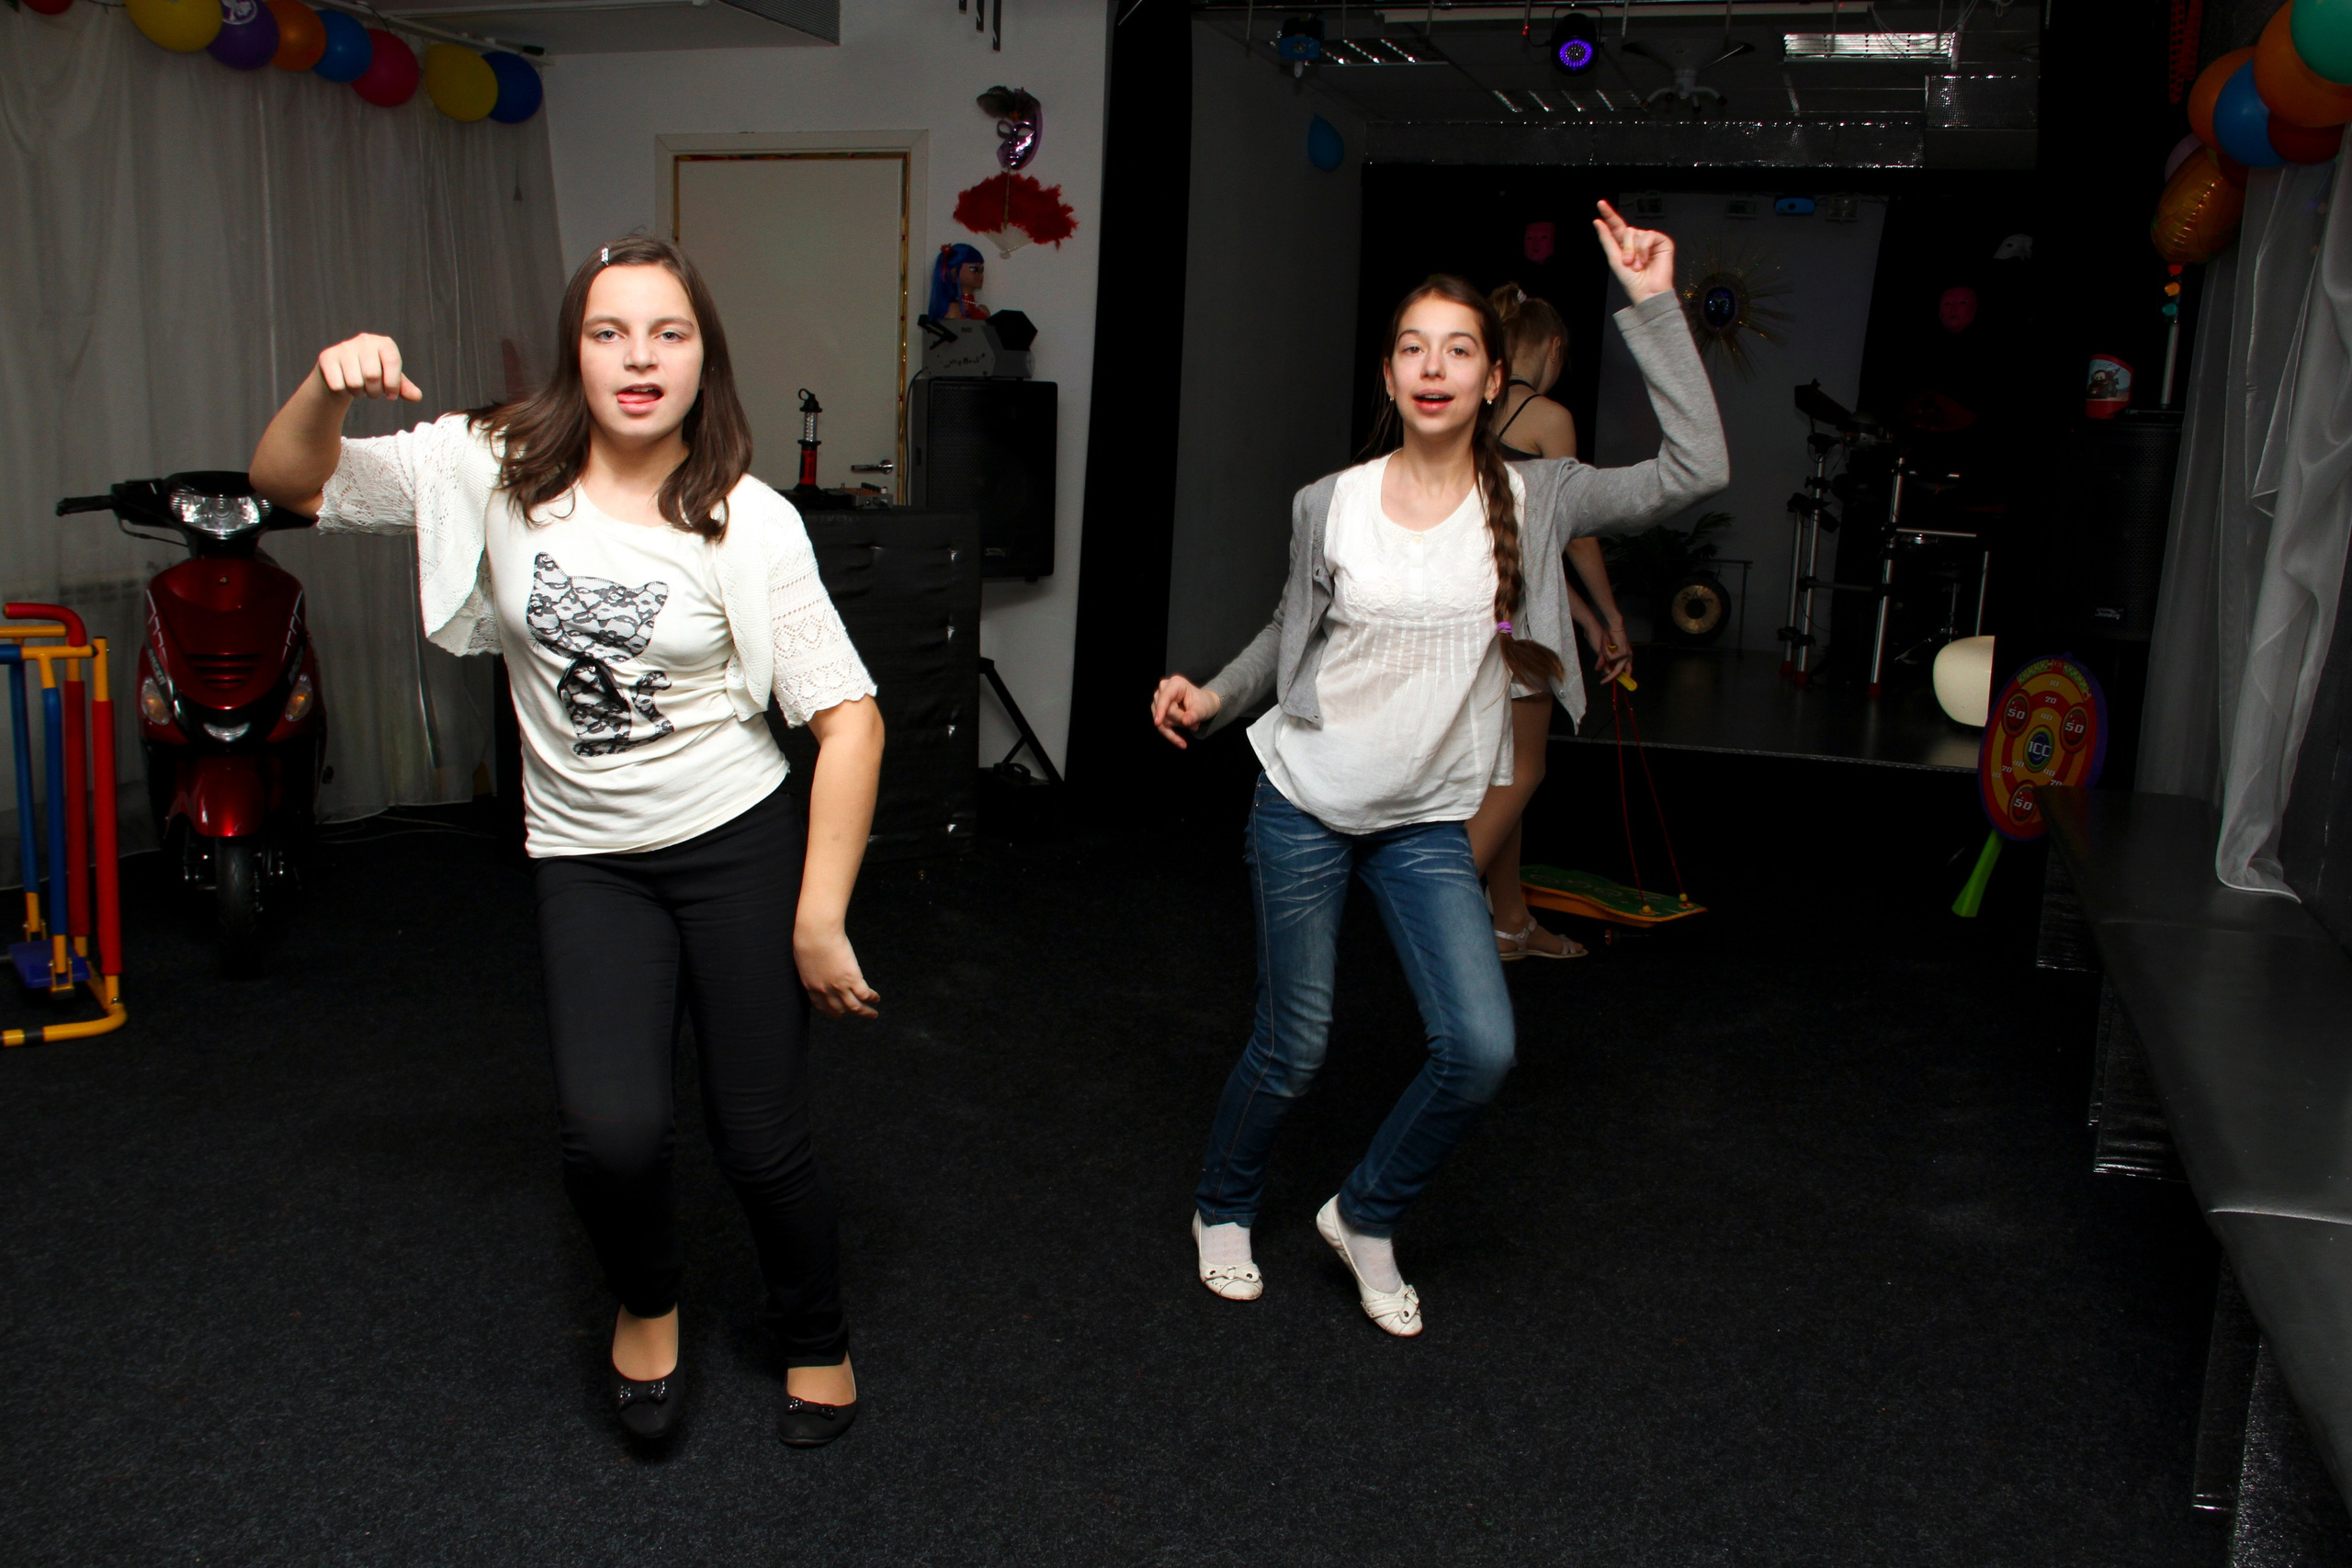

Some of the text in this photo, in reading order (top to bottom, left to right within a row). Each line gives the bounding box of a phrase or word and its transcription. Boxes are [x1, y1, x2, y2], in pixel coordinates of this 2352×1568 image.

[2044, 695, 2057, 705] 20
[2007, 708, 2026, 720] 50
[2040, 713, 2053, 721] 40
[2065, 722, 2085, 734] 50
[2001, 765, 2013, 773] 20
[2014, 798, 2033, 811] 50
